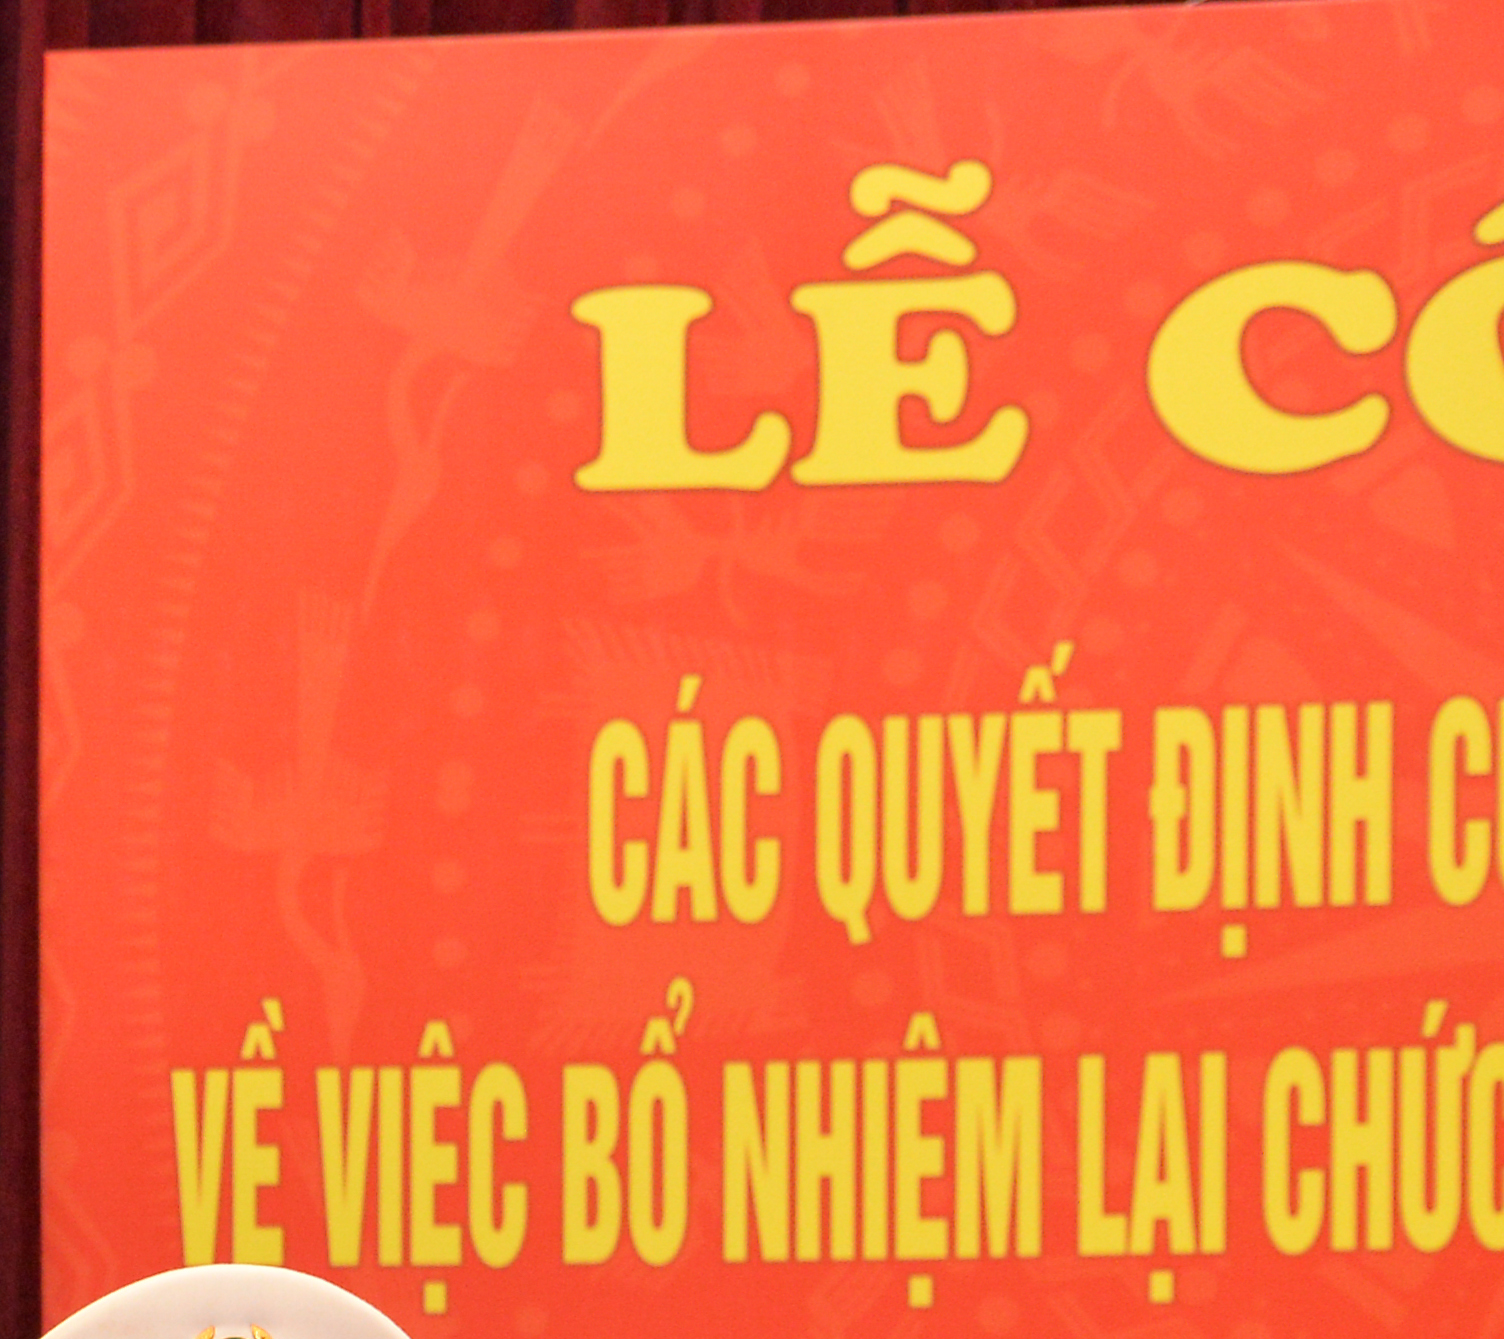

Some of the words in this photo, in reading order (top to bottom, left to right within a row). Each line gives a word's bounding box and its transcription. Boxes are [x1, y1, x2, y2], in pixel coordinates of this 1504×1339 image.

[571, 160, 1029, 492] LỄ
[588, 673, 782, 925] CÁC
[815, 641, 1123, 944] QUYẾT
[1149, 701, 1393, 957] ĐỊNH
[171, 997, 284, 1267] VỀ
[316, 1020, 527, 1315] VIỆC
[562, 976, 694, 1267] BỔ
[722, 1011, 1042, 1308] NHIỆM
[1077, 1051, 1227, 1303] LẠI
